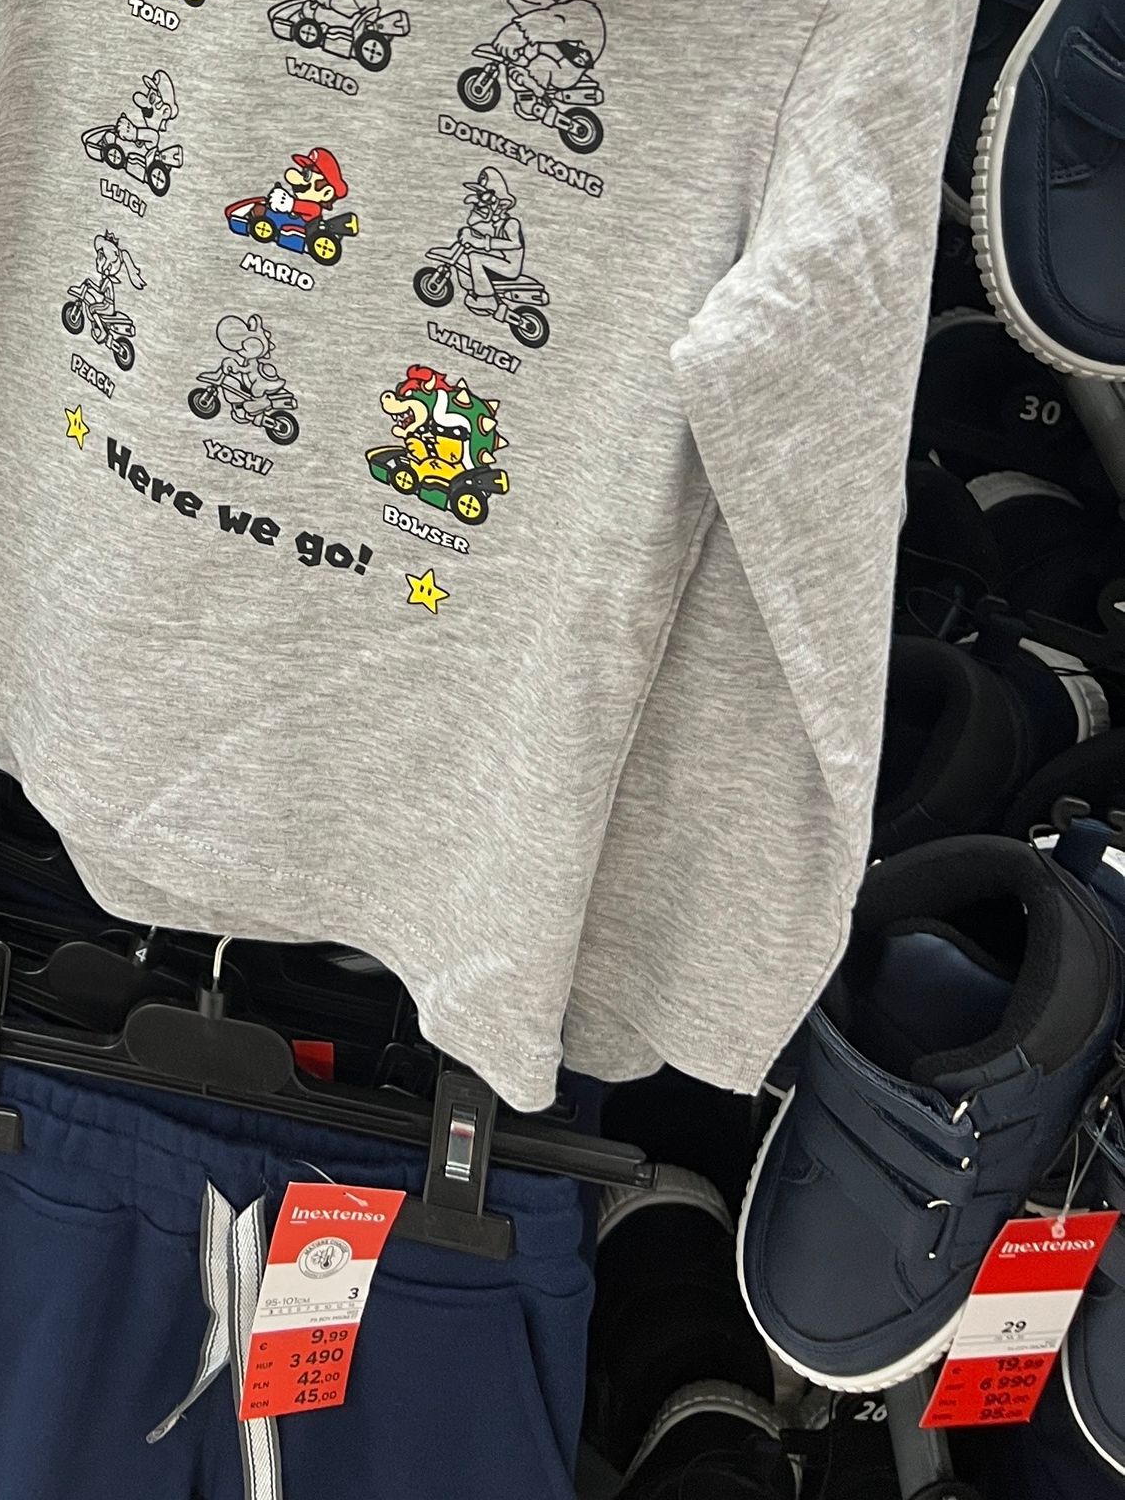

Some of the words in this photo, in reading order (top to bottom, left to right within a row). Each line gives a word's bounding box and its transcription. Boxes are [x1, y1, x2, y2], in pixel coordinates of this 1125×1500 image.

[285, 57, 360, 96] WARIO
[438, 114, 536, 166] DONKEY
[538, 153, 604, 199] KONG
[99, 178, 148, 218] LUIGI
[241, 253, 315, 291] MARIO
[427, 321, 523, 374] WALUIGI
[70, 354, 116, 399] PEACH
[1019, 395, 1062, 426] 30
[202, 439, 274, 476] YOSHI
[106, 437, 204, 519] Here
[217, 504, 281, 546] we
[295, 531, 374, 576] go!
[383, 504, 470, 555] BOWSER
[135, 947, 148, 963] 4
[291, 1206, 386, 1223] Inextenso
[1001, 1239, 1096, 1254] Inextenso
[347, 1287, 360, 1300] 3
[1002, 1320, 1027, 1334] 29
[259, 1342, 268, 1351] €
[854, 1401, 888, 1422] 26
